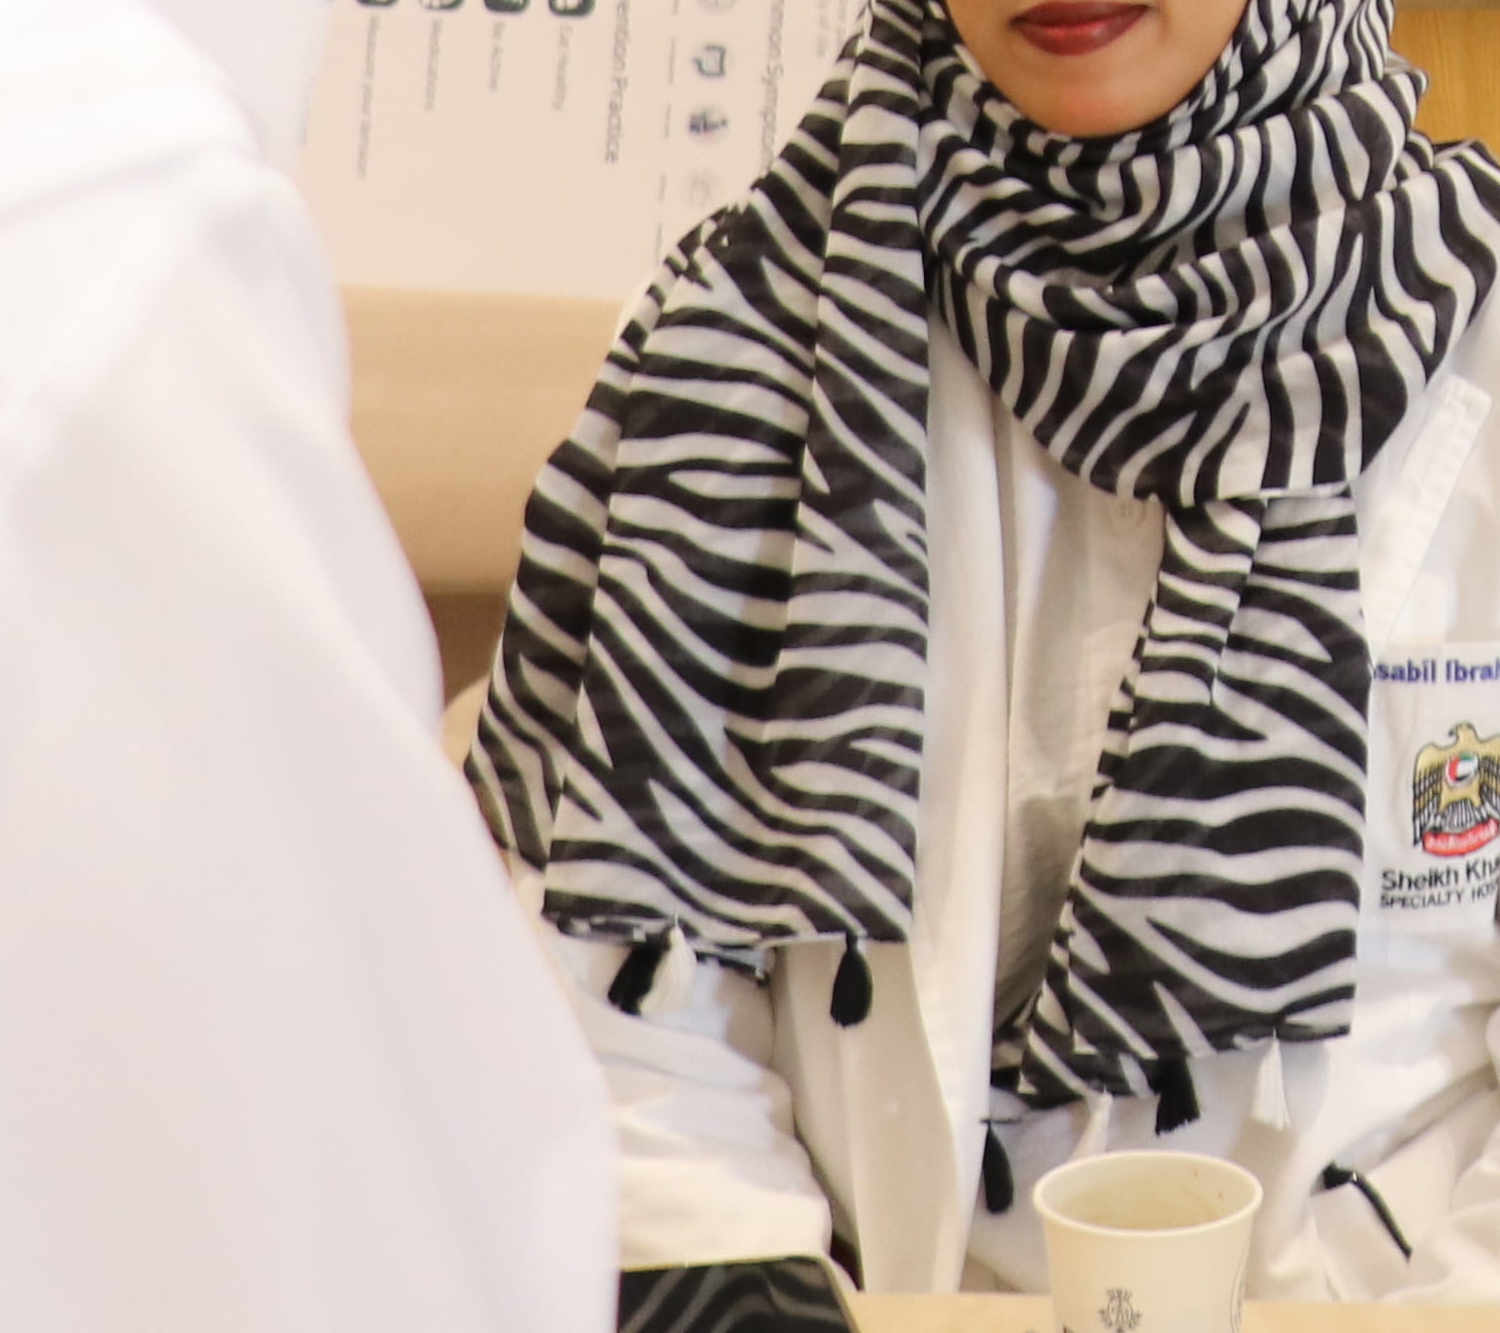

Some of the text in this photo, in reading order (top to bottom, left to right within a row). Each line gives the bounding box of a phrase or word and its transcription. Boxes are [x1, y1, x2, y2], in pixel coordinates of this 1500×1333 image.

[605, 77, 627, 163] Practice
[1373, 658, 1436, 682] sabil
[1381, 866, 1459, 891] Sheikh
